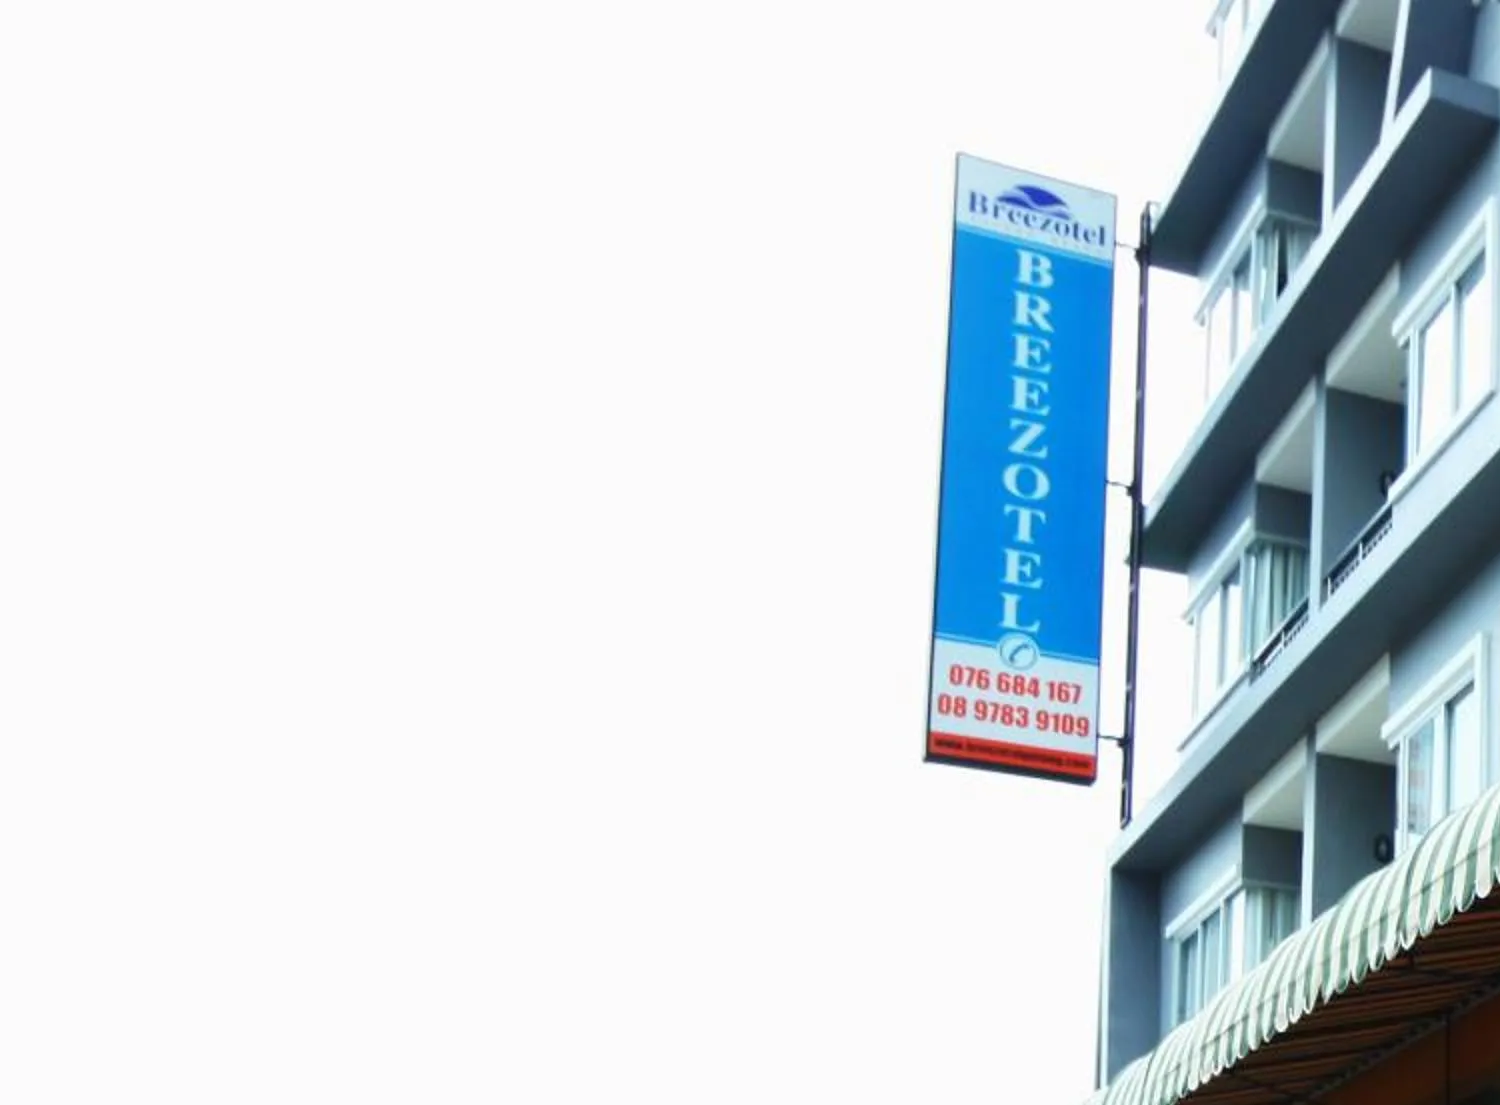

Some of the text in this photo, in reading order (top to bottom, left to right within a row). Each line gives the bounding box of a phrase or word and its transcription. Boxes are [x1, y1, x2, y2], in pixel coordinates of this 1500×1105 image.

[968, 191, 1106, 246] Breezotel
[998, 249, 1055, 634] BREEZOTEL
[949, 664, 1082, 704] 076 684 167
[938, 693, 1089, 737] 08 9783 9109
